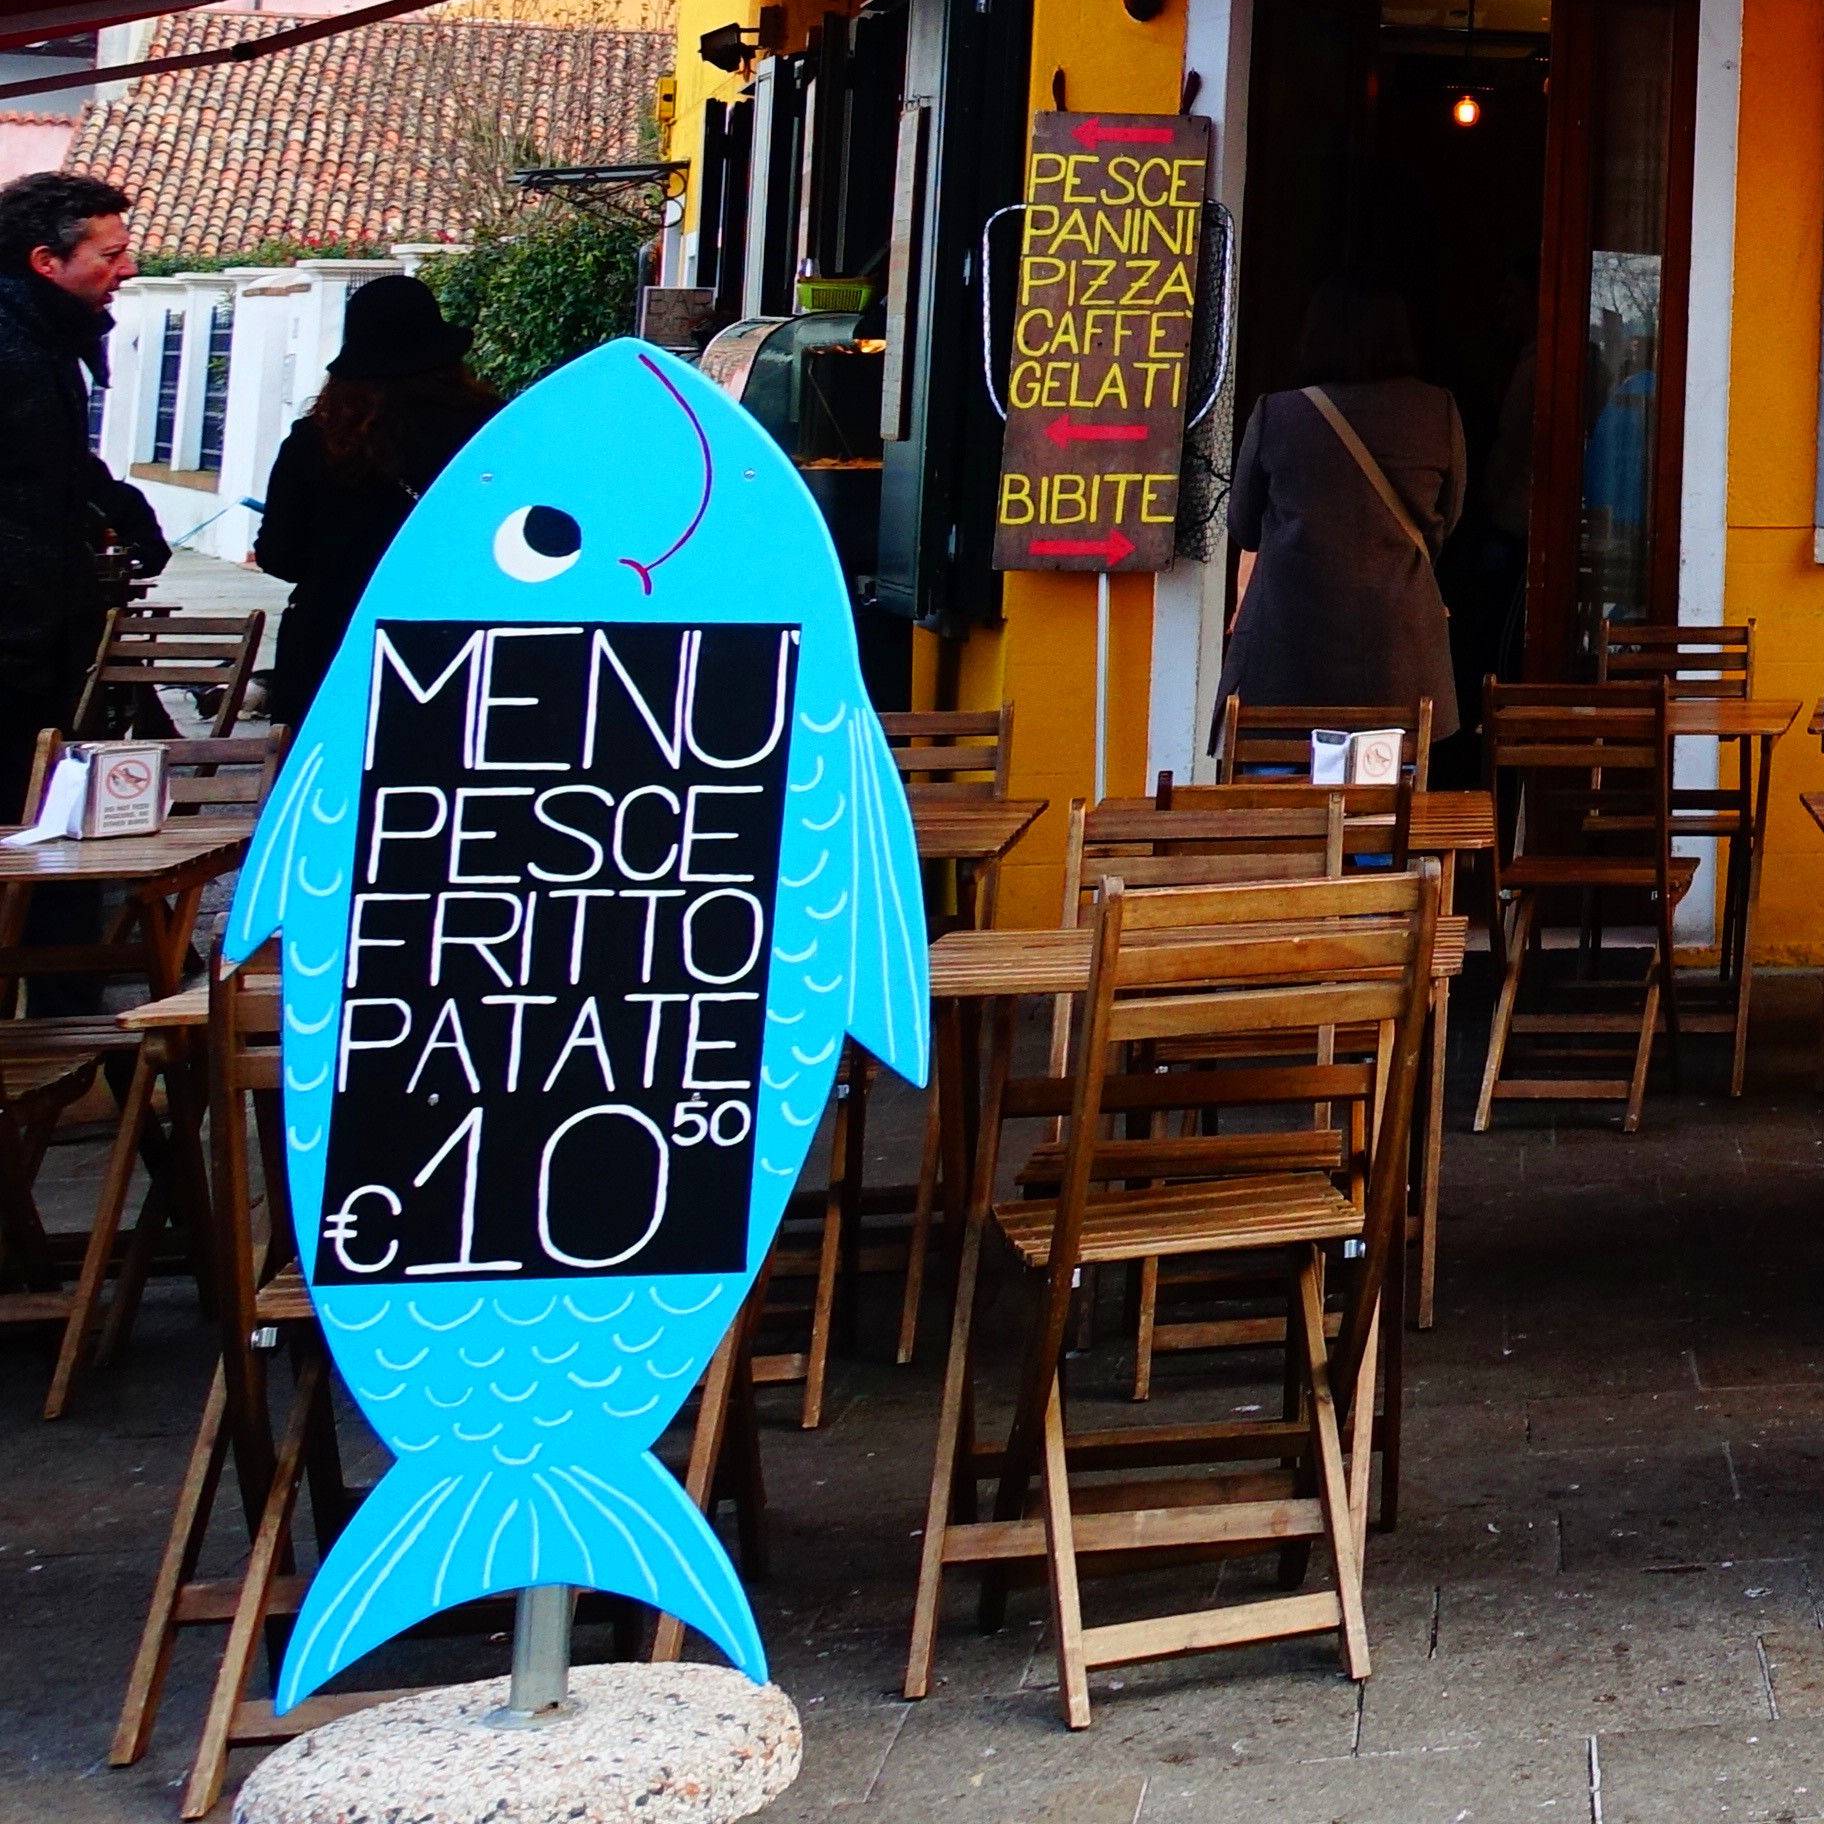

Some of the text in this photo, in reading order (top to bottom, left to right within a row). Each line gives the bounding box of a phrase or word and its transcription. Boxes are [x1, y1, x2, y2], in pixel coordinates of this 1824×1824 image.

[1026, 153, 1206, 209] PESCE
[1021, 203, 1197, 256] PANINI
[1020, 256, 1195, 307] PIZZA
[1009, 360, 1182, 410] GELATI
[999, 473, 1179, 526] BIBITE
[366, 784, 764, 885] PESCE
[346, 887, 765, 989] FRITTO
[337, 991, 760, 1094] PATATE
